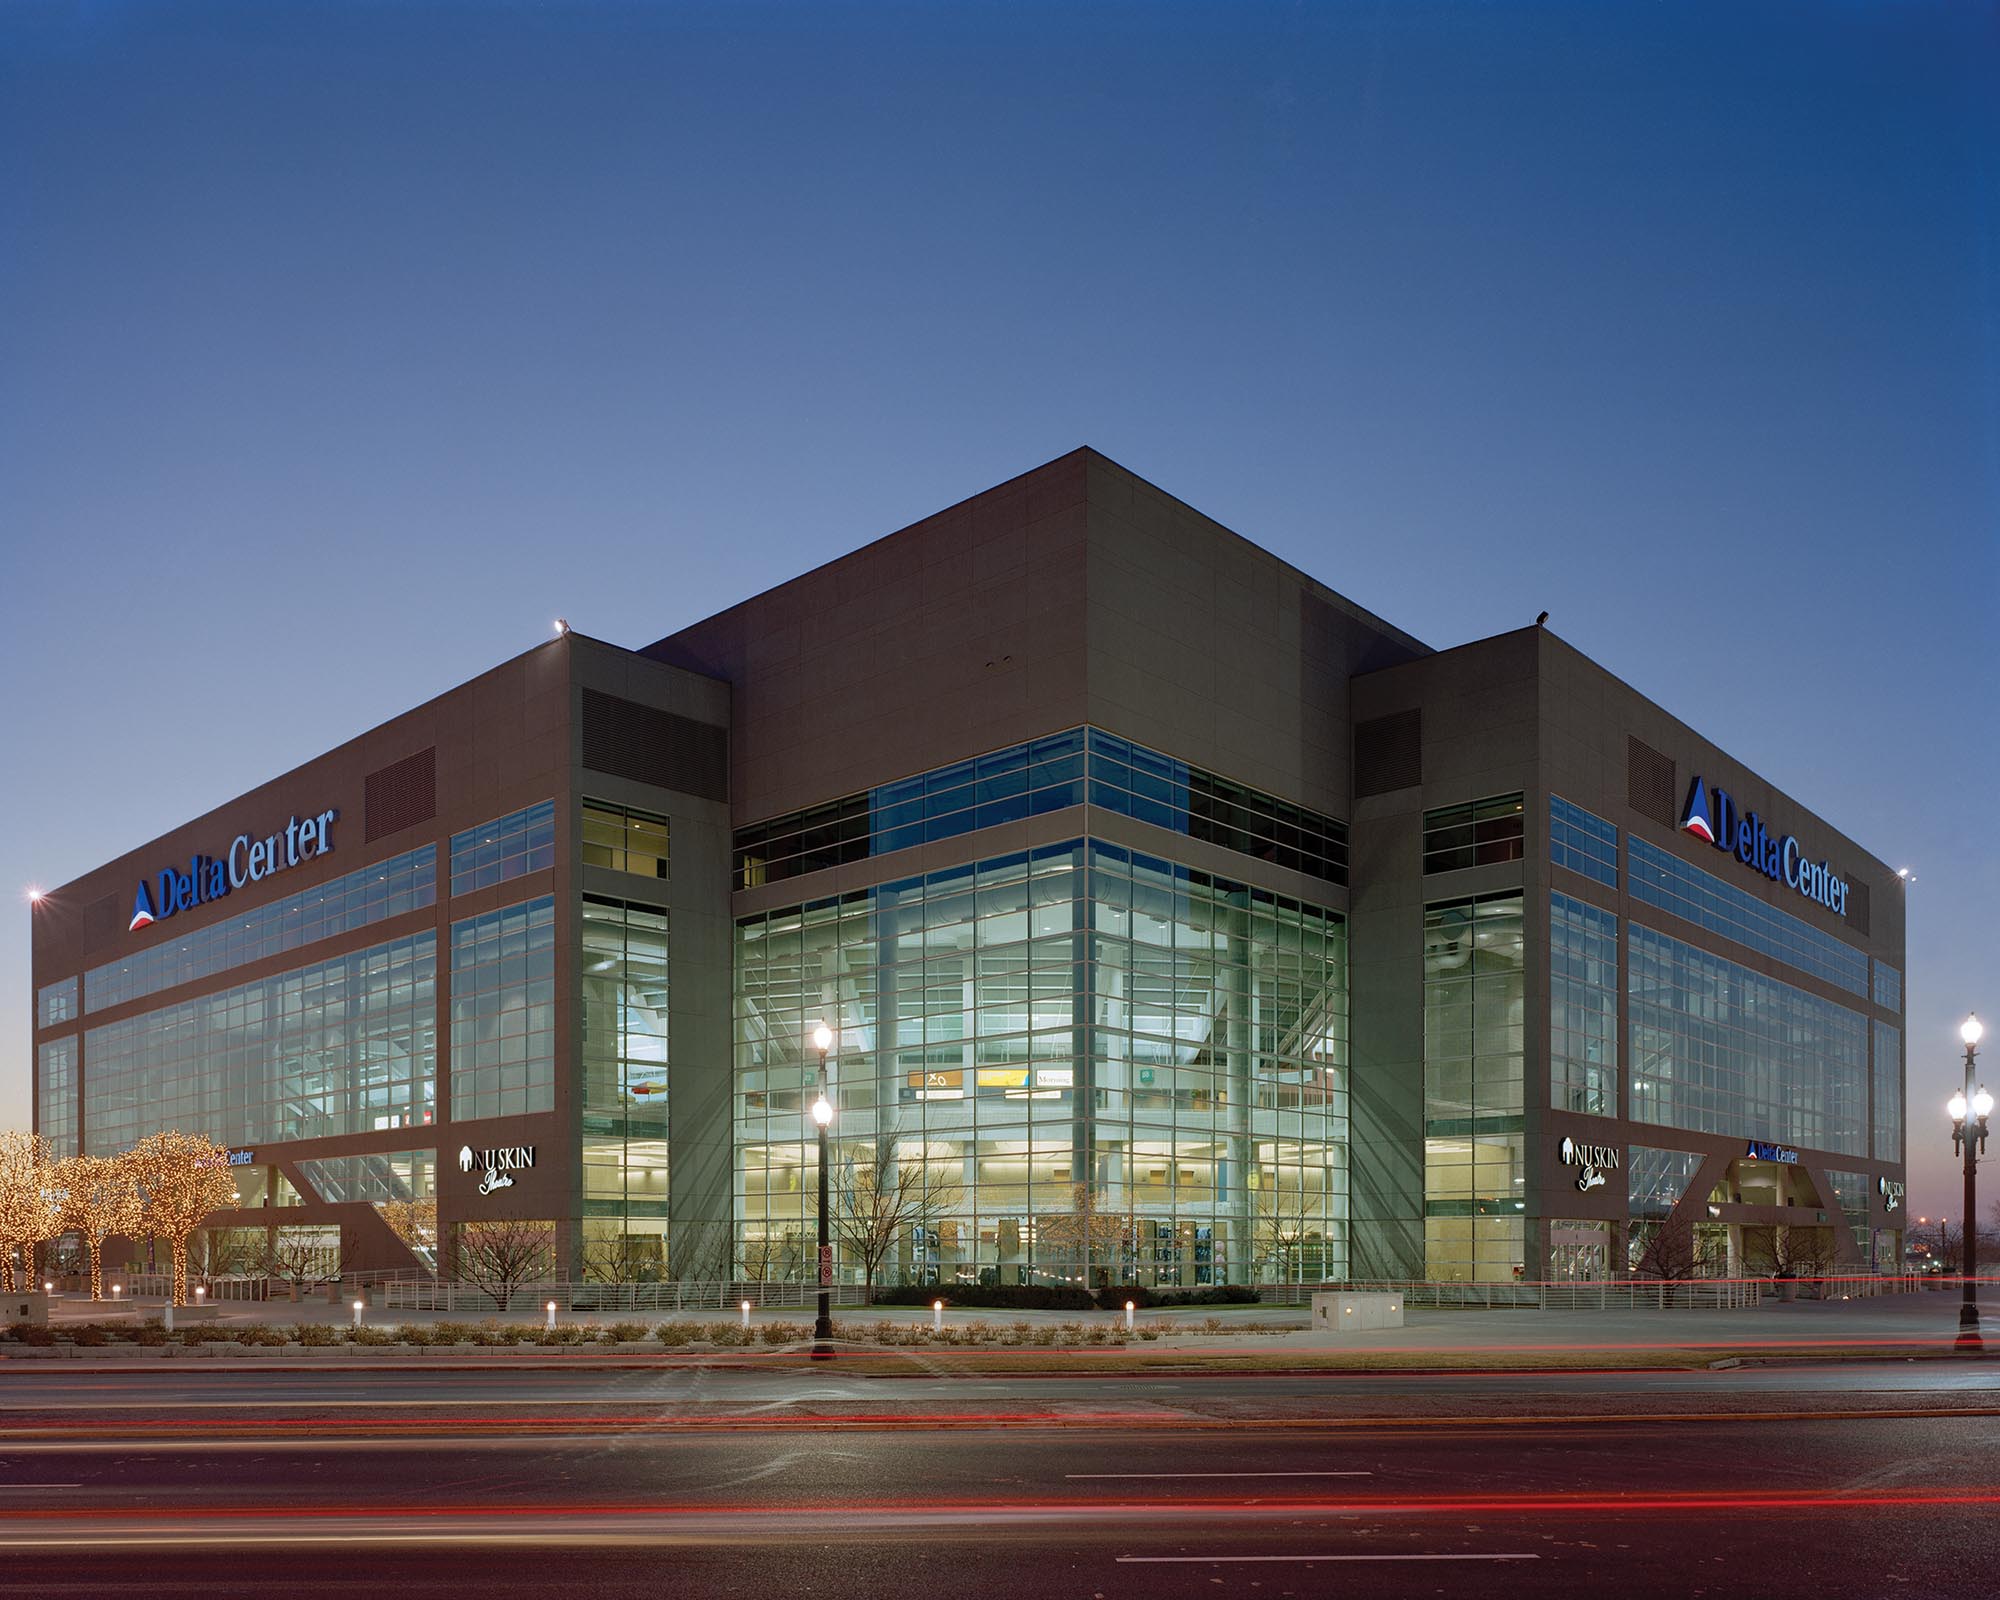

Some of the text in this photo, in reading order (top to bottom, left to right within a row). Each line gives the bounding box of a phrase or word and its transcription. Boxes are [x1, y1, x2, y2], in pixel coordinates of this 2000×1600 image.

[157, 809, 336, 920] Delta Center
[1712, 788, 1849, 917] Delta Center
[475, 1146, 533, 1170] NU SKIN
[1575, 1144, 1619, 1168] NU SKIN
[1776, 1146, 1798, 1164] Center
